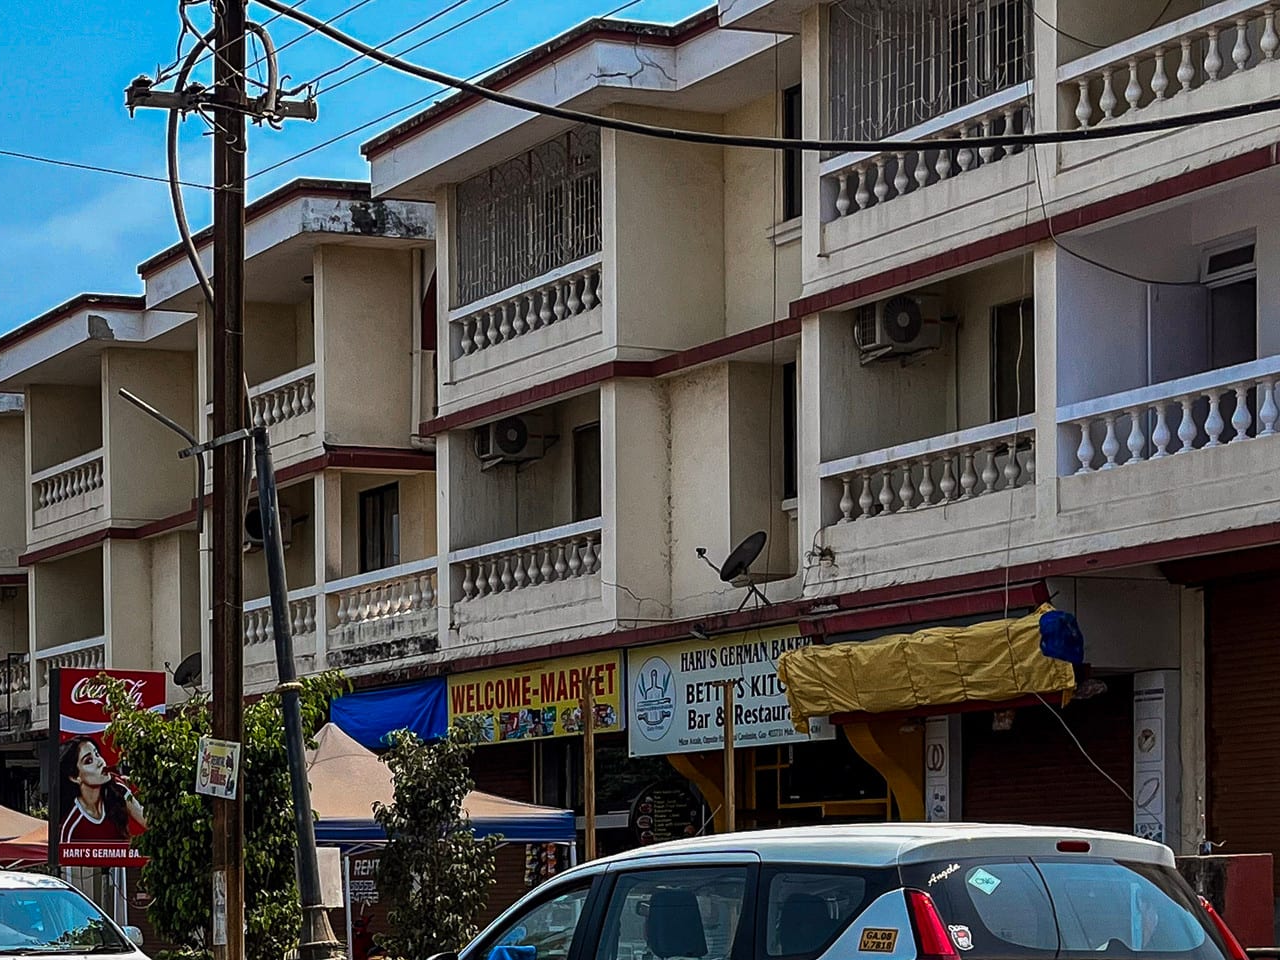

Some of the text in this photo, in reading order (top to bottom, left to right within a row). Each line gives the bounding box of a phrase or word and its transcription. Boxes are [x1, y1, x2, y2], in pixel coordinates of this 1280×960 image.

[681, 648, 718, 673] HARI'S
[720, 640, 768, 667] GERMAN
[451, 662, 617, 715] WELCOME-MARKET
[751, 672, 787, 697] KITC
[687, 708, 711, 731] Bar
[715, 705, 725, 727] &
[63, 848, 142, 858] HARI'S GERMAN BA
